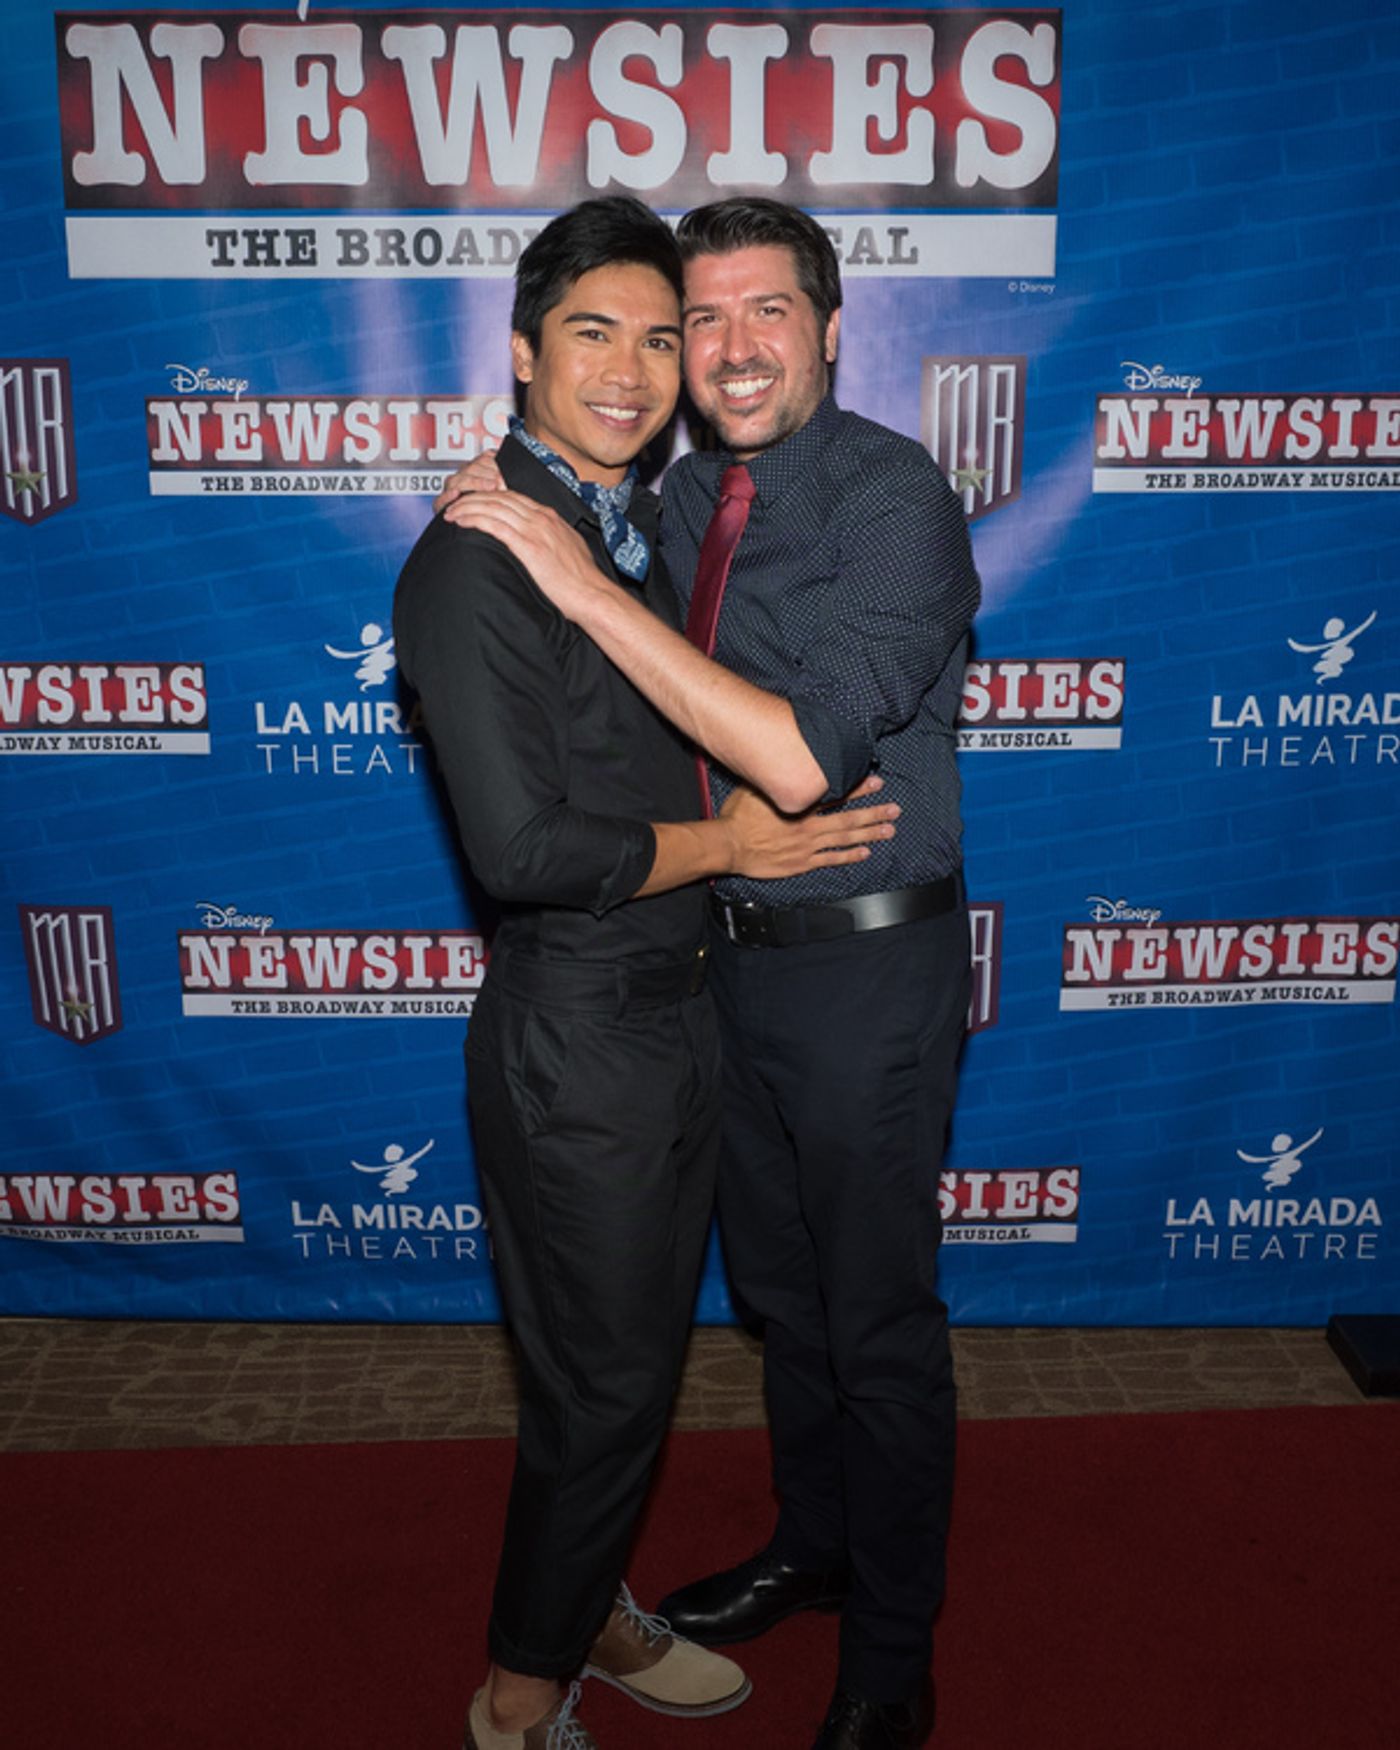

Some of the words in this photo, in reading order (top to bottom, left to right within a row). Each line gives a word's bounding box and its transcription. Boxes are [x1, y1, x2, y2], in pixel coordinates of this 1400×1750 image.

[65, 20, 1057, 189] NEWSIES
[206, 228, 317, 268] THE
[1020, 280, 1056, 295] Disney
[166, 363, 249, 401] Disney
[1120, 361, 1202, 398] Disney
[1098, 397, 1400, 460] NEWSIE
[201, 476, 247, 491] THE
[250, 475, 367, 491] BROADWAY
[373, 475, 443, 491] MUSIC
[1145, 474, 1189, 488] THE
[1192, 473, 1305, 488] BROADWAY
[960, 661, 1124, 721] SIES
[255, 702, 311, 734] LA
[1211, 695, 1264, 728] LA
[1277, 693, 1400, 728] MIRAD
[0, 736, 62, 750] DWAY
[68, 736, 162, 750] MUSICAL
[981, 732, 1072, 748] MUSICAL
[1208, 734, 1400, 767] THEATR
[256, 744, 423, 774] THEAT
[196, 903, 274, 935] Disney
[1086, 896, 1161, 926] Disney
[181, 936, 486, 989] NEWSIE
[1064, 922, 1399, 982] NEWSIES
[232, 1000, 274, 1014] THE
[277, 1000, 385, 1014] BROADWAY
[391, 1001, 473, 1014] MUSICA
[1108, 992, 1149, 1007] THE
[1151, 987, 1257, 1005] BROADWAY
[1260, 986, 1350, 1003] MUSICAL
[291, 1201, 342, 1228] LA
[352, 1203, 488, 1231] MIRAD
[1165, 1198, 1215, 1227] LA
[1228, 1198, 1383, 1227] MIRADA
[7, 1227, 106, 1240] BROADWAY
[113, 1229, 200, 1242] MUSICAL
[292, 1232, 494, 1260] THEATR
[945, 1228, 1031, 1240] MUSICAL
[1162, 1233, 1379, 1260] THEATRE
